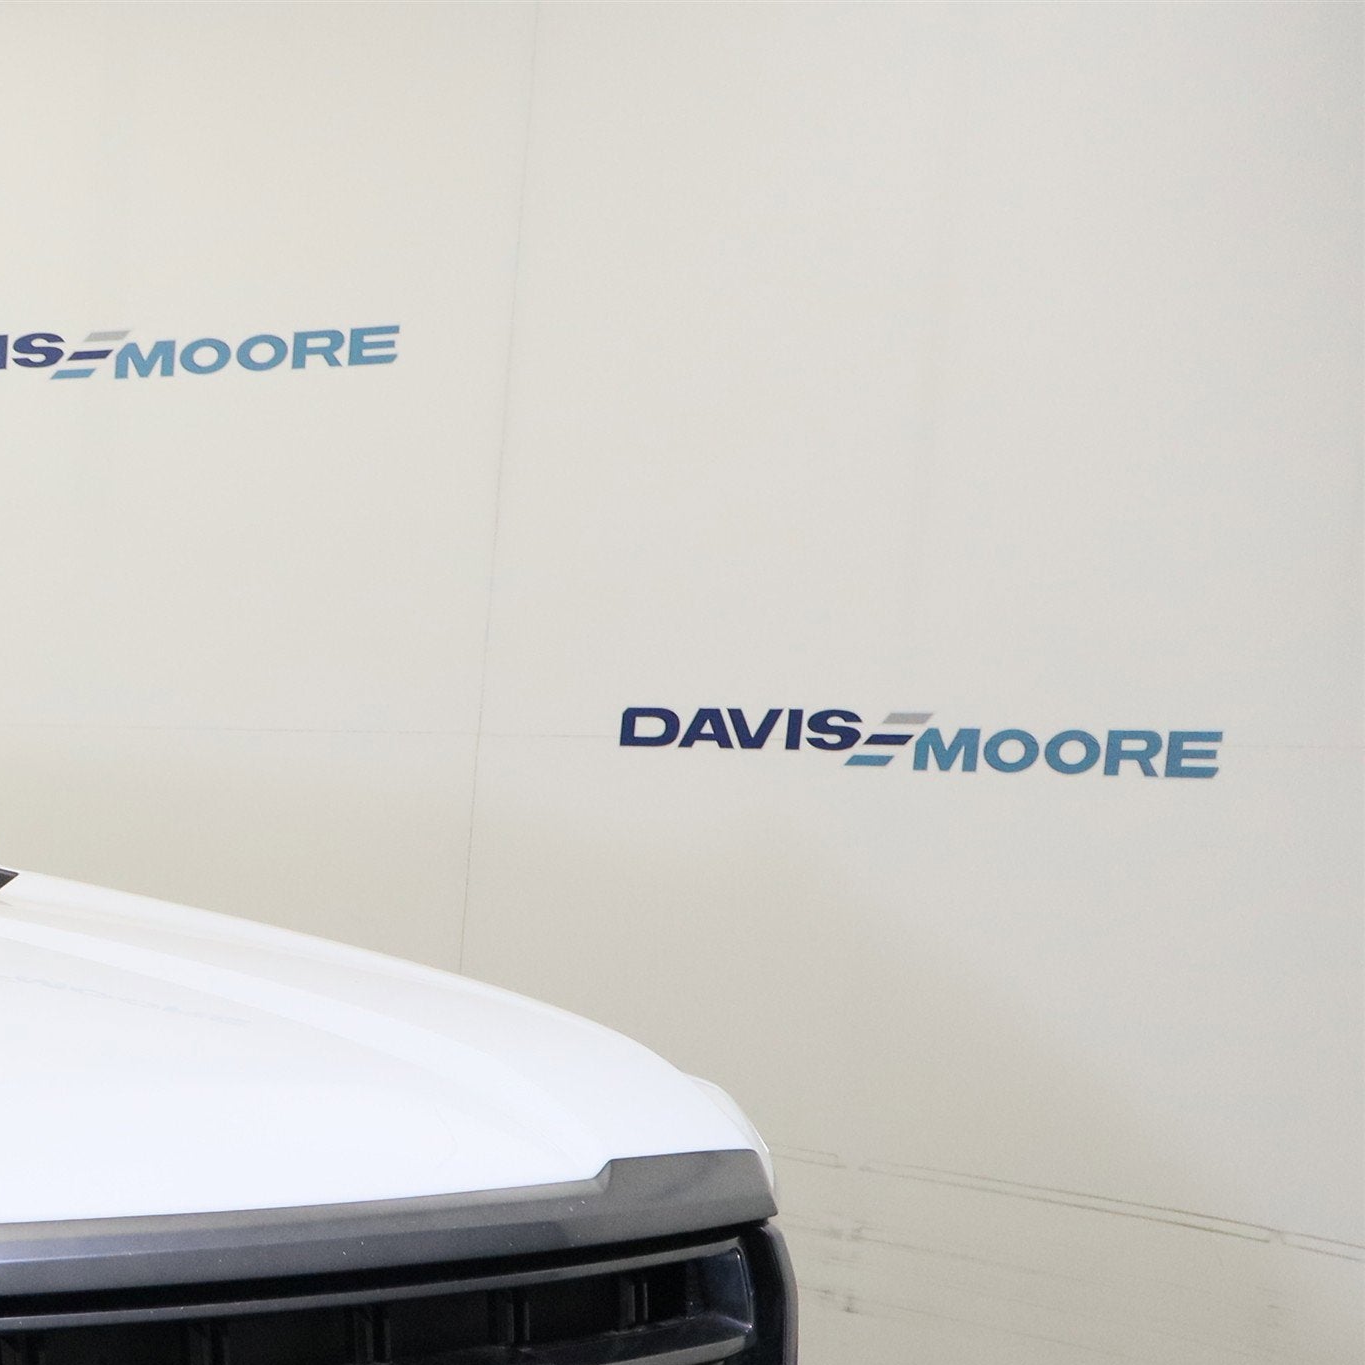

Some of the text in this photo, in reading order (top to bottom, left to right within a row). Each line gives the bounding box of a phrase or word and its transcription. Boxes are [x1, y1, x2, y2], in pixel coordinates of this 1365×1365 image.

[114, 324, 400, 380] MOORE
[619, 706, 1224, 779] DAVIS MOORE
